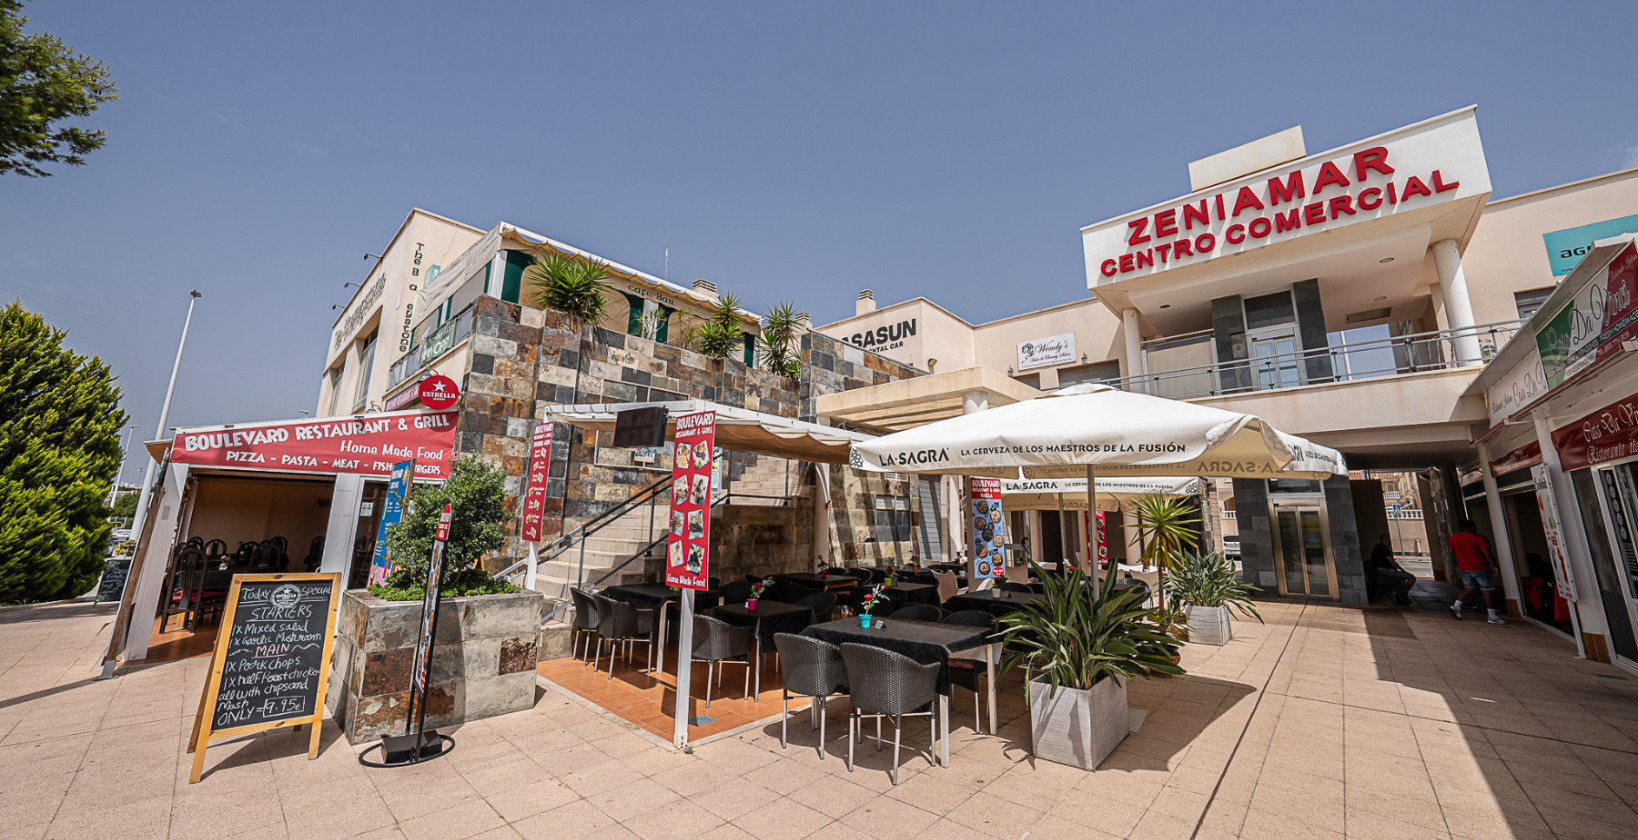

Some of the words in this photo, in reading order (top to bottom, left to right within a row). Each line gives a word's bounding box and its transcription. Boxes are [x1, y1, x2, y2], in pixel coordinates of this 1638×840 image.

[1128, 147, 1395, 246] ZENIAMAR
[1100, 233, 1216, 277] CENTRO
[1225, 169, 1460, 243] COMERCIAL
[1568, 304, 1594, 345] Da
[1590, 279, 1630, 326] Vinci
[890, 341, 904, 350] CAR
[1034, 339, 1068, 354] Wendy's
[422, 391, 456, 399] ESTRELLA
[677, 413, 714, 430] BOULEVARD
[1583, 421, 1602, 442] Casa
[1601, 412, 1620, 433] Da
[185, 427, 289, 452] BOULEVARD
[296, 419, 391, 441] RESTAURANT
[397, 417, 408, 431] &
[413, 413, 450, 429] GRILL
[340, 440, 378, 455] Home
[382, 443, 413, 458] Made
[417, 446, 444, 460] Food
[973, 447, 1011, 456] CERVEZA
[1026, 445, 1043, 453] LOS
[1046, 444, 1101, 453] MAESTROS
[1103, 444, 1117, 452] DE
[1119, 444, 1134, 452] LA
[1138, 441, 1186, 453] FUSIÓN
[226, 451, 265, 463] PIZZA
[281, 454, 318, 467] PASTA
[332, 458, 360, 469] MEAT
[372, 460, 393, 472] FISH
[415, 464, 441, 475] RGERS
[241, 587, 271, 601] Today
[251, 604, 312, 620] STARTERS
[244, 622, 276, 635] Mixed
[279, 619, 308, 633] salad
[255, 643, 290, 657] MAIN
[218, 690, 235, 701] all
[217, 706, 254, 726] ONLY
